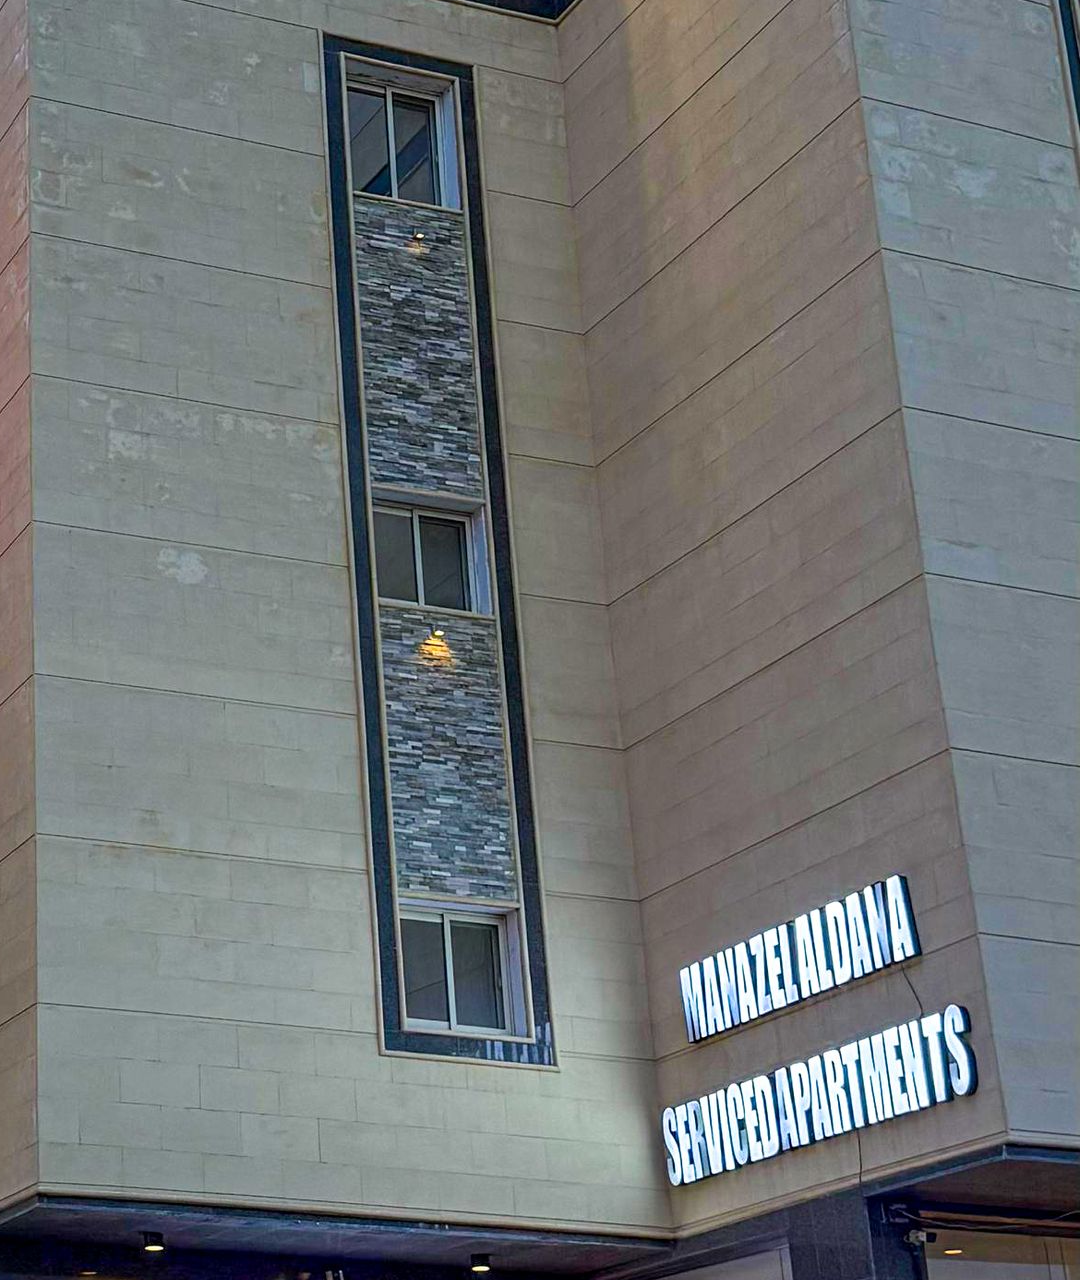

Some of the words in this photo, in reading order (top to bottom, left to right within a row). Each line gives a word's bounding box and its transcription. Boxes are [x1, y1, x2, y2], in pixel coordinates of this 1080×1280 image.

[679, 924, 799, 1043] MANAZEL
[794, 874, 918, 999] ALDANA
[662, 1075, 781, 1187] SERVICED
[775, 1004, 973, 1151] APARTMENTS
